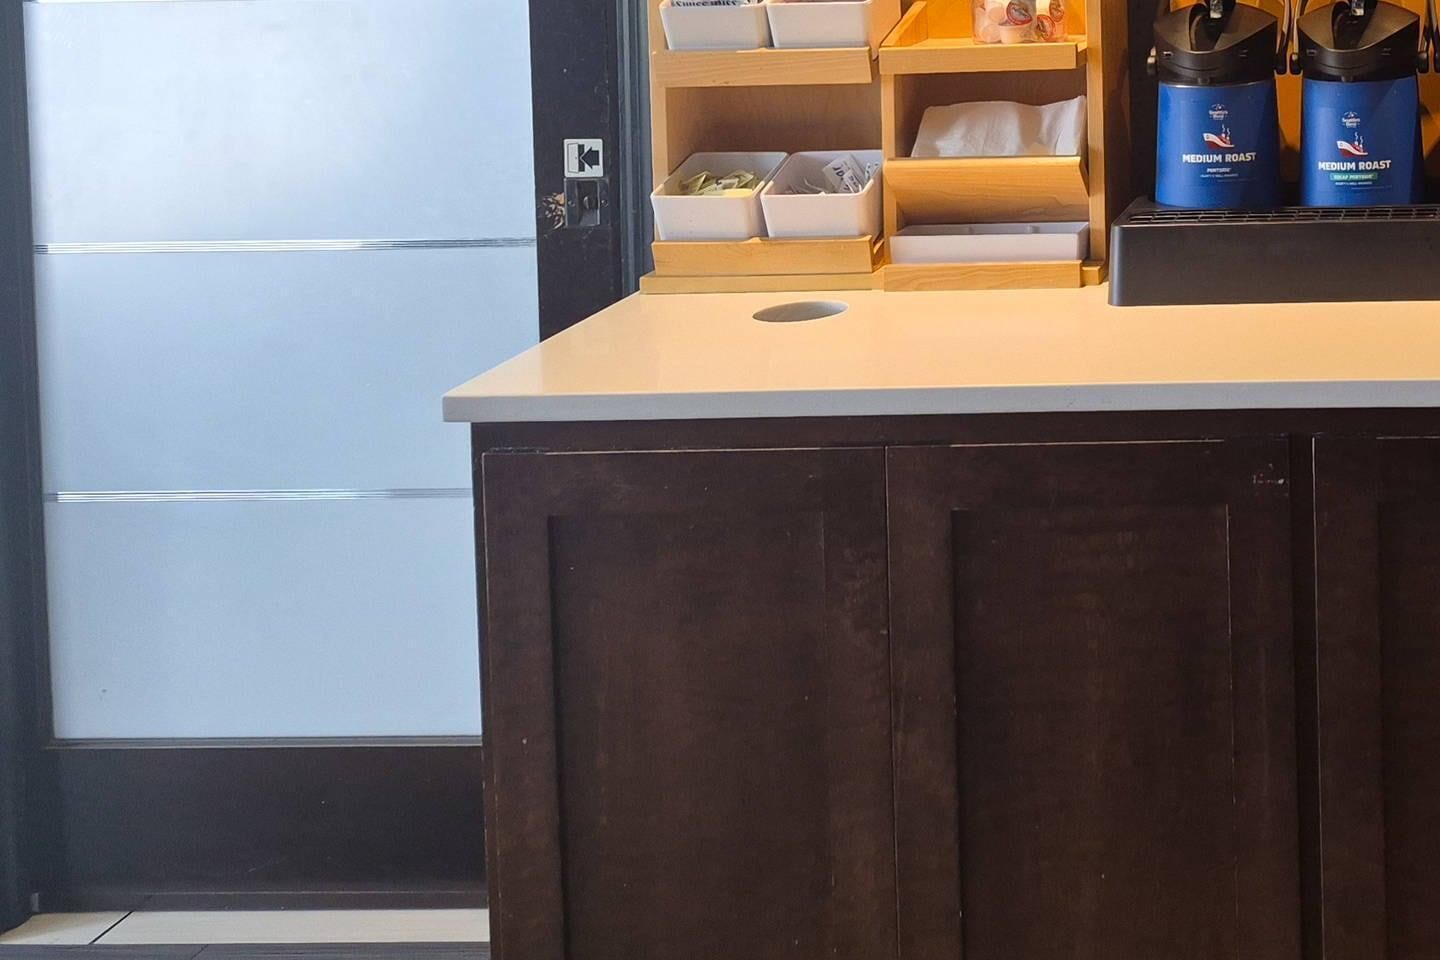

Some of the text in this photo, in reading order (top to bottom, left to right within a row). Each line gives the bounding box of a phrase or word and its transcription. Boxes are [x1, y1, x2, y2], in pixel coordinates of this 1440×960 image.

[1182, 152, 1256, 163] MEDIUM ROAST
[1318, 160, 1391, 170] MEDIUM ROAST
